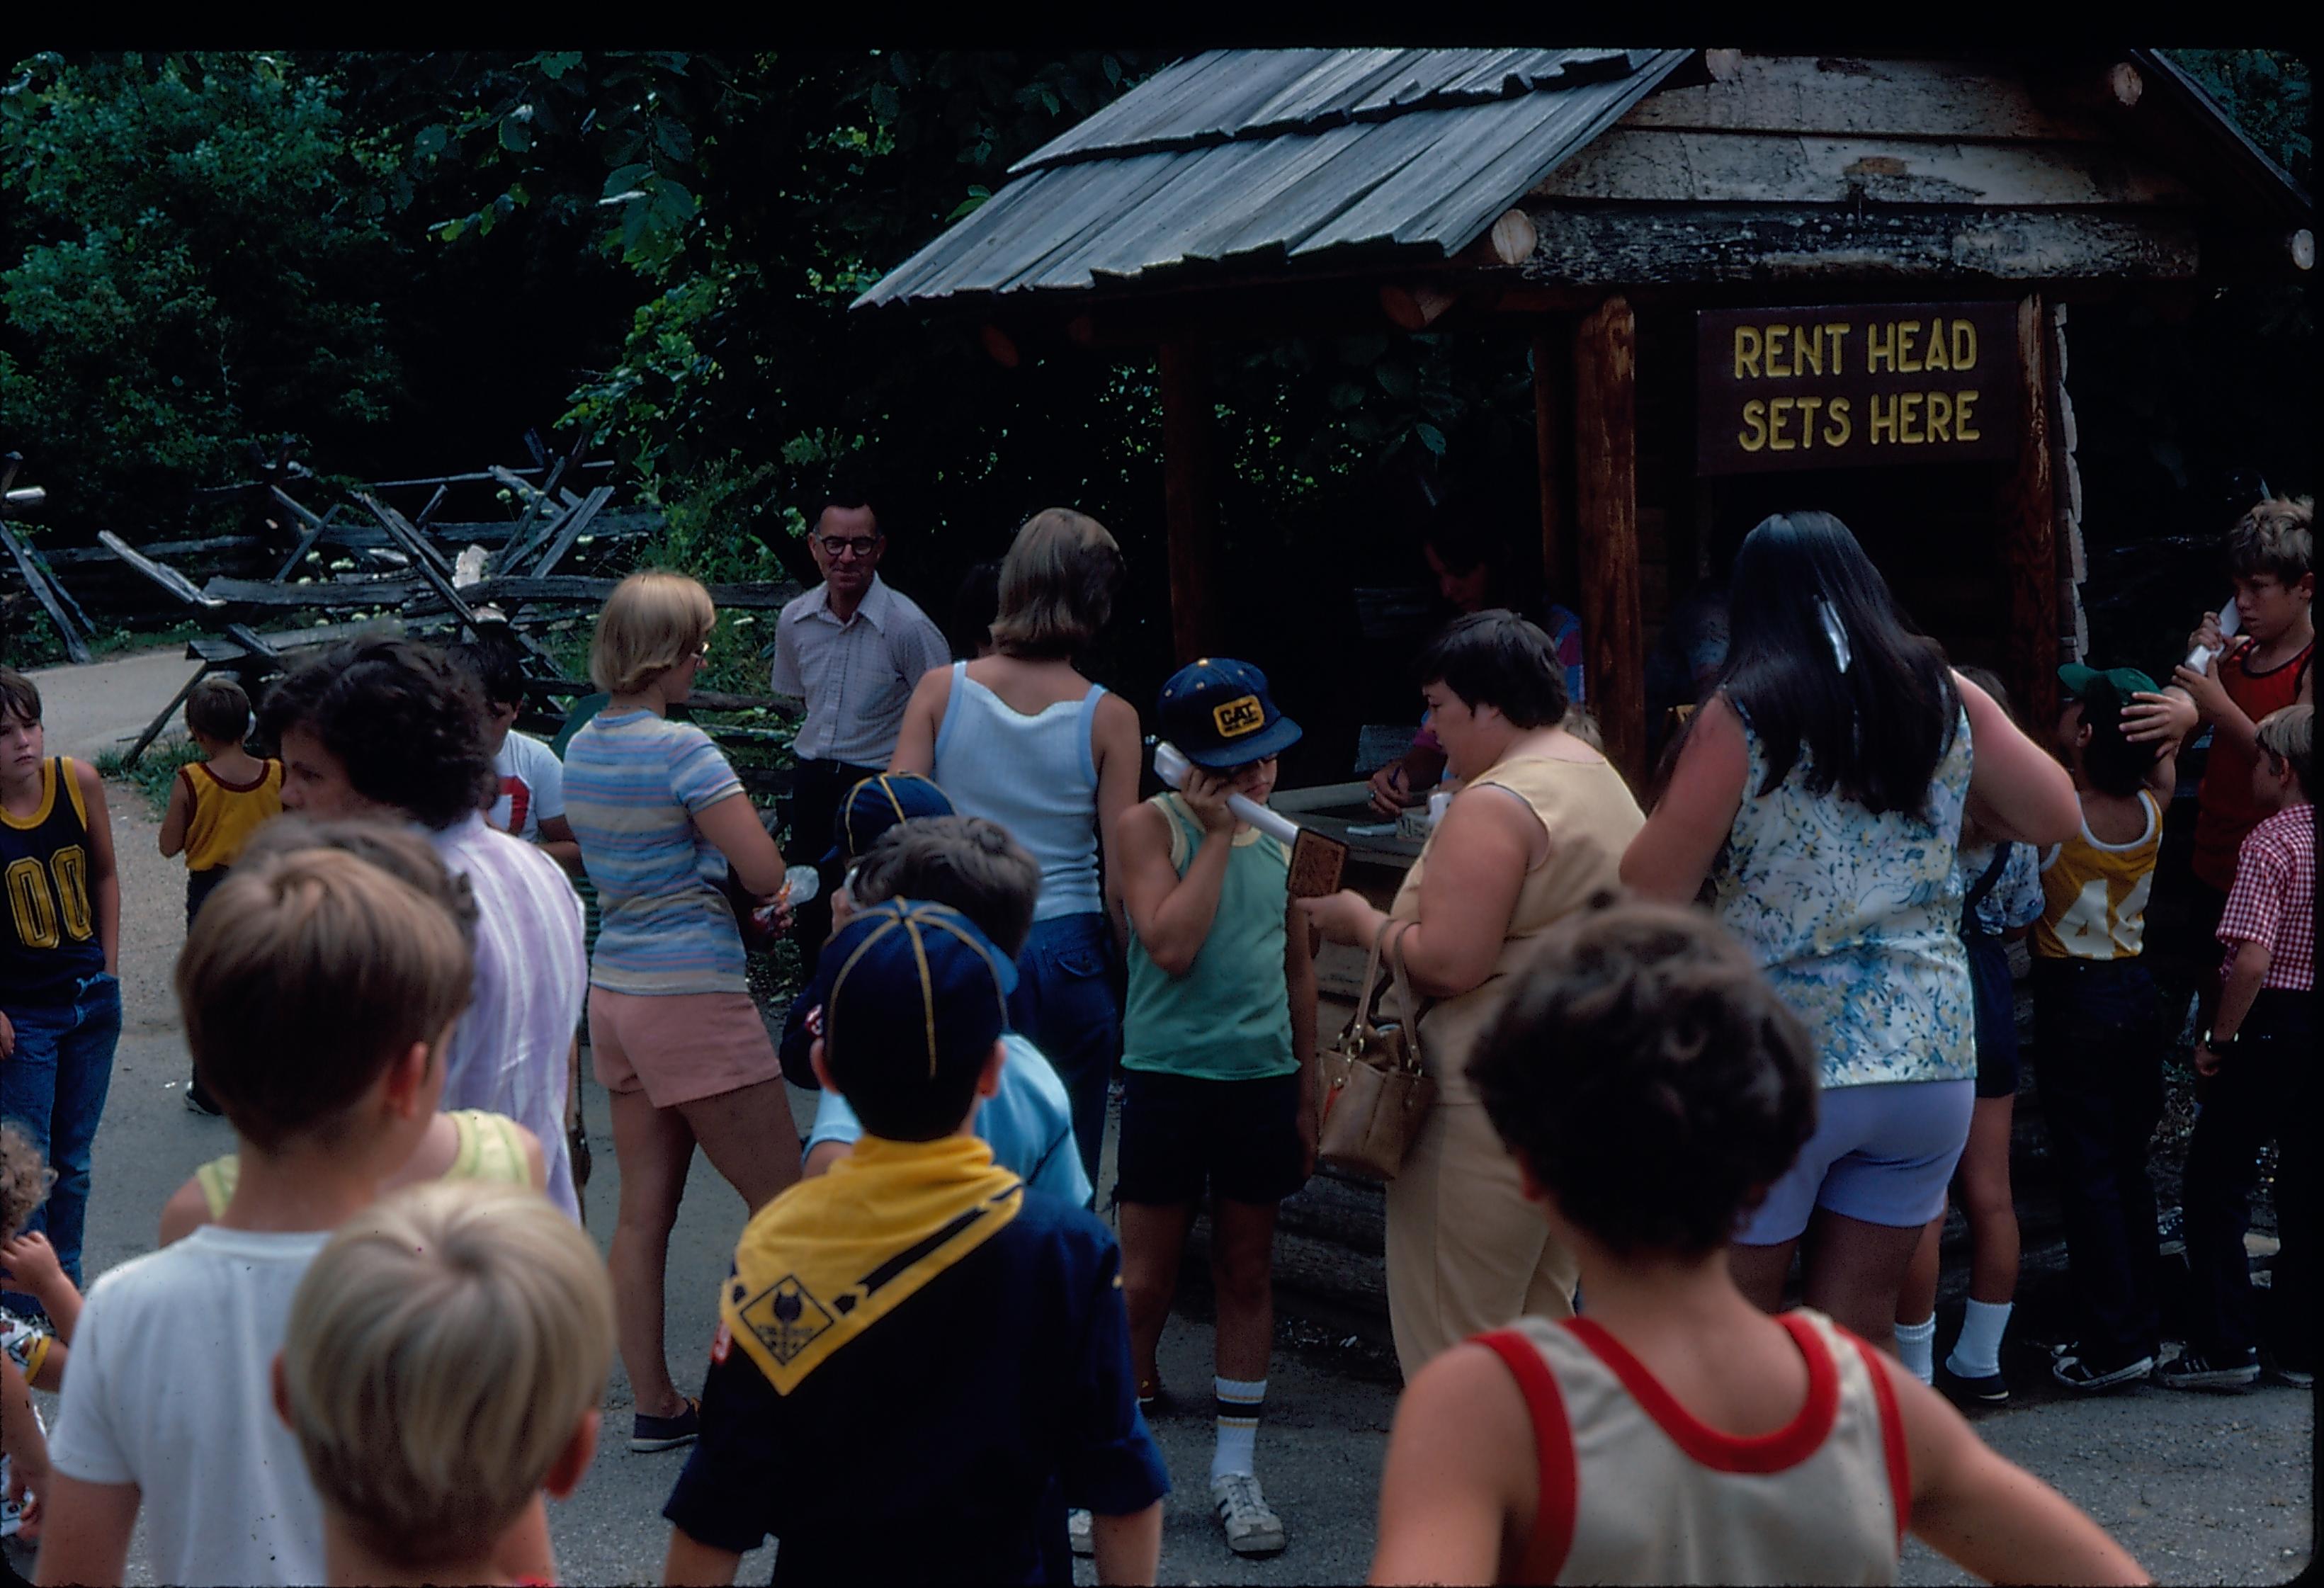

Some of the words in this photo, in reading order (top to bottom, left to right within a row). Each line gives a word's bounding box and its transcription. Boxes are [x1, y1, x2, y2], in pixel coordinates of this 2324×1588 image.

[1734, 322, 1852, 380] RENT
[1866, 317, 1978, 375] HEAD
[1738, 396, 1852, 452] SETS
[1869, 390, 1981, 445] HERE
[1220, 702, 1253, 725] CAT
[4, 844, 93, 949] 00
